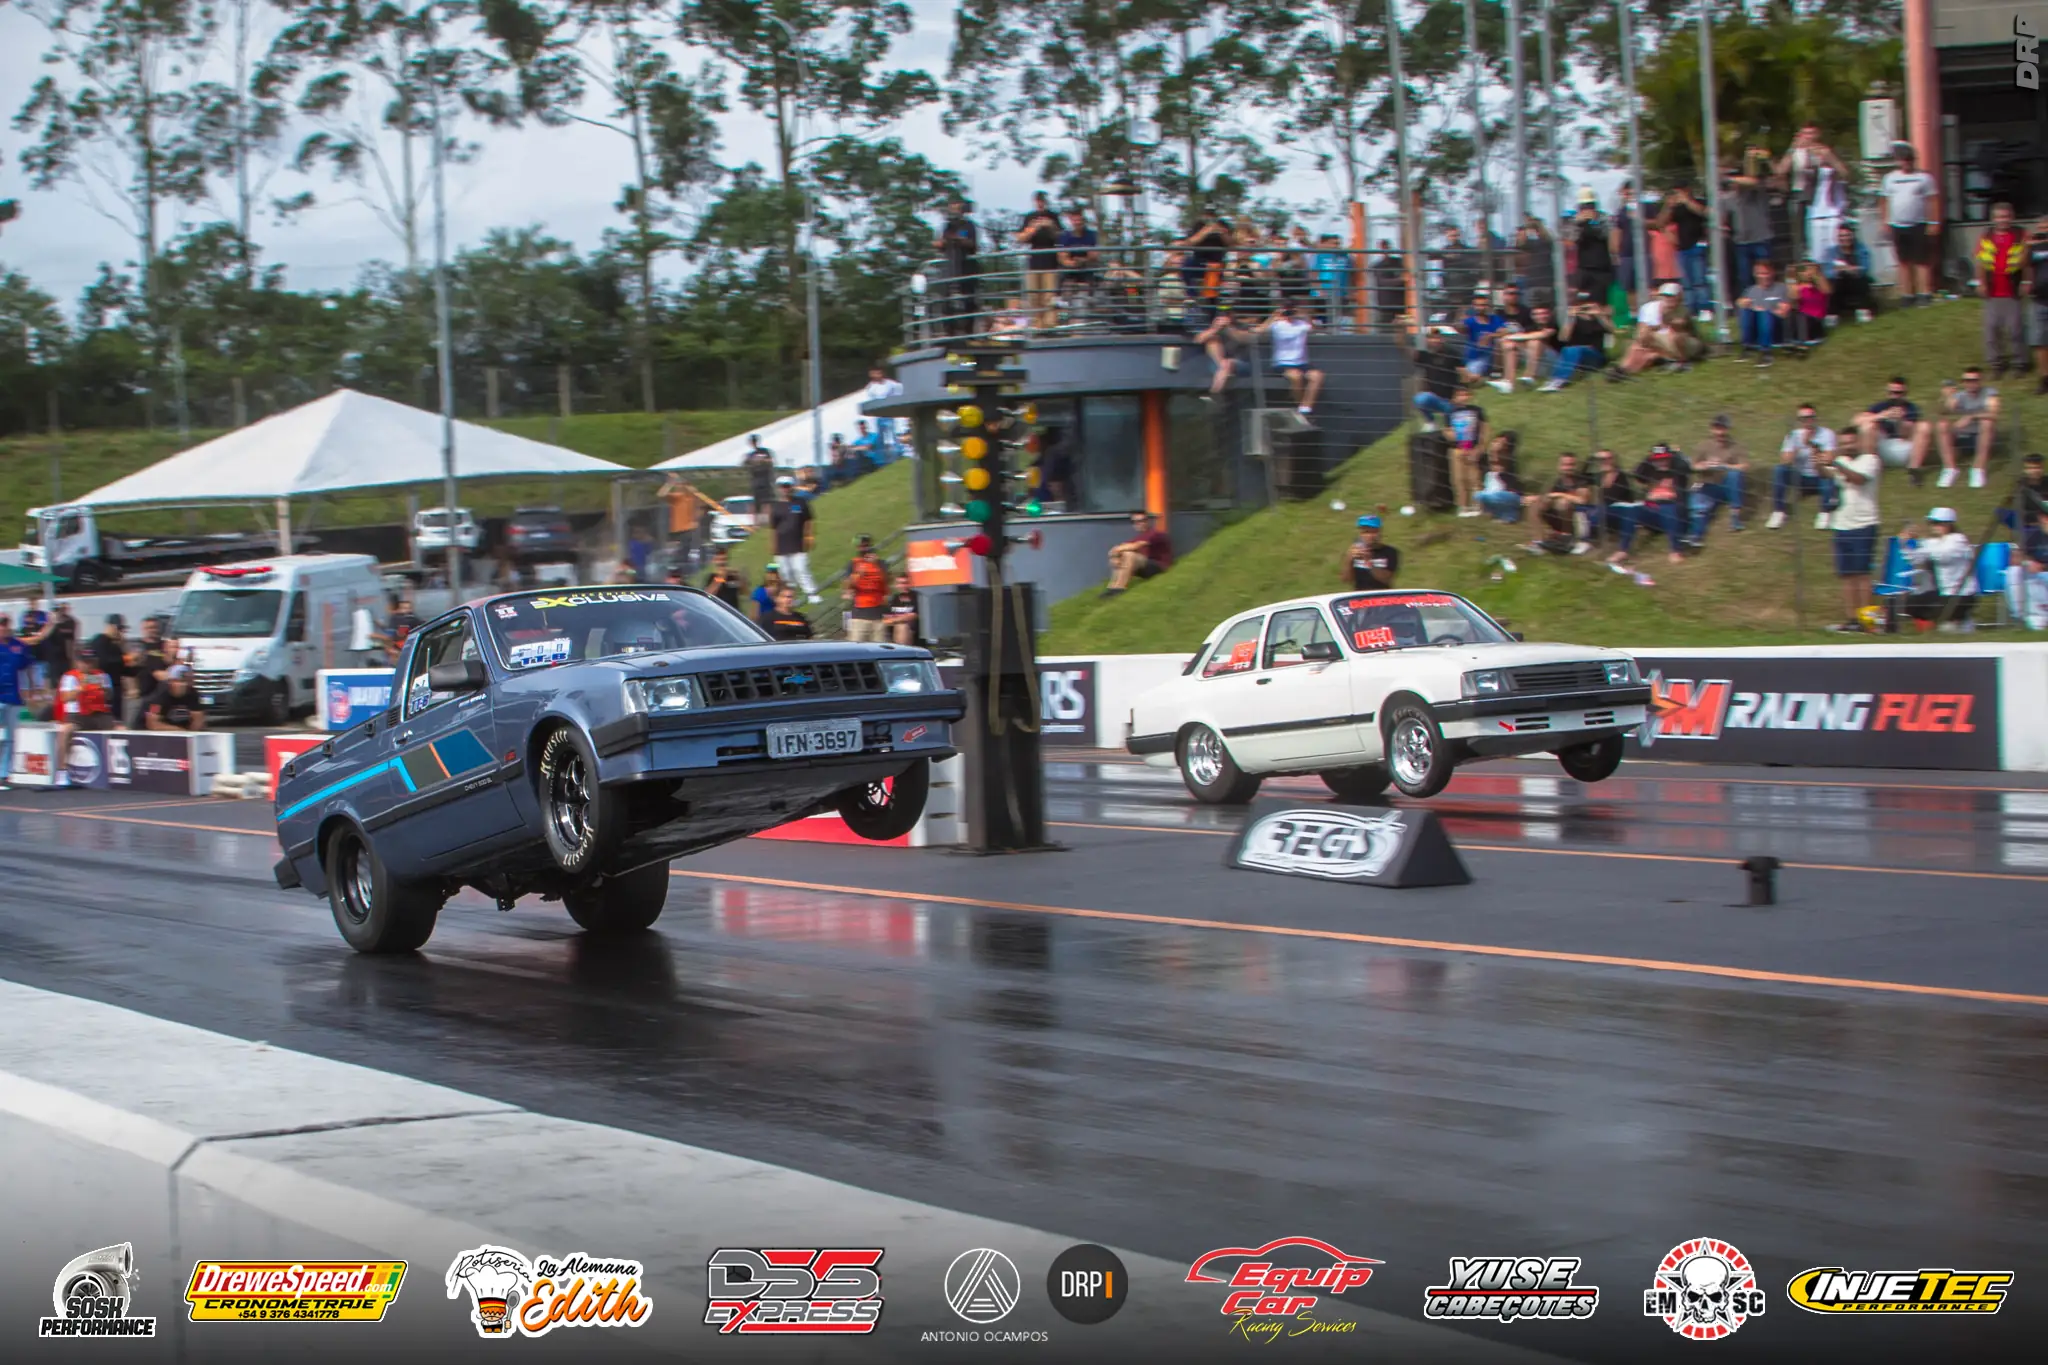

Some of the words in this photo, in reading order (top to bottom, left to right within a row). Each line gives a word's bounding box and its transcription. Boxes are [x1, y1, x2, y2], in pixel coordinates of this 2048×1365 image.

[530, 593, 671, 609] EXCLUSIVE
[1725, 692, 1873, 731] RACING
[1871, 693, 1976, 733] FUEL
